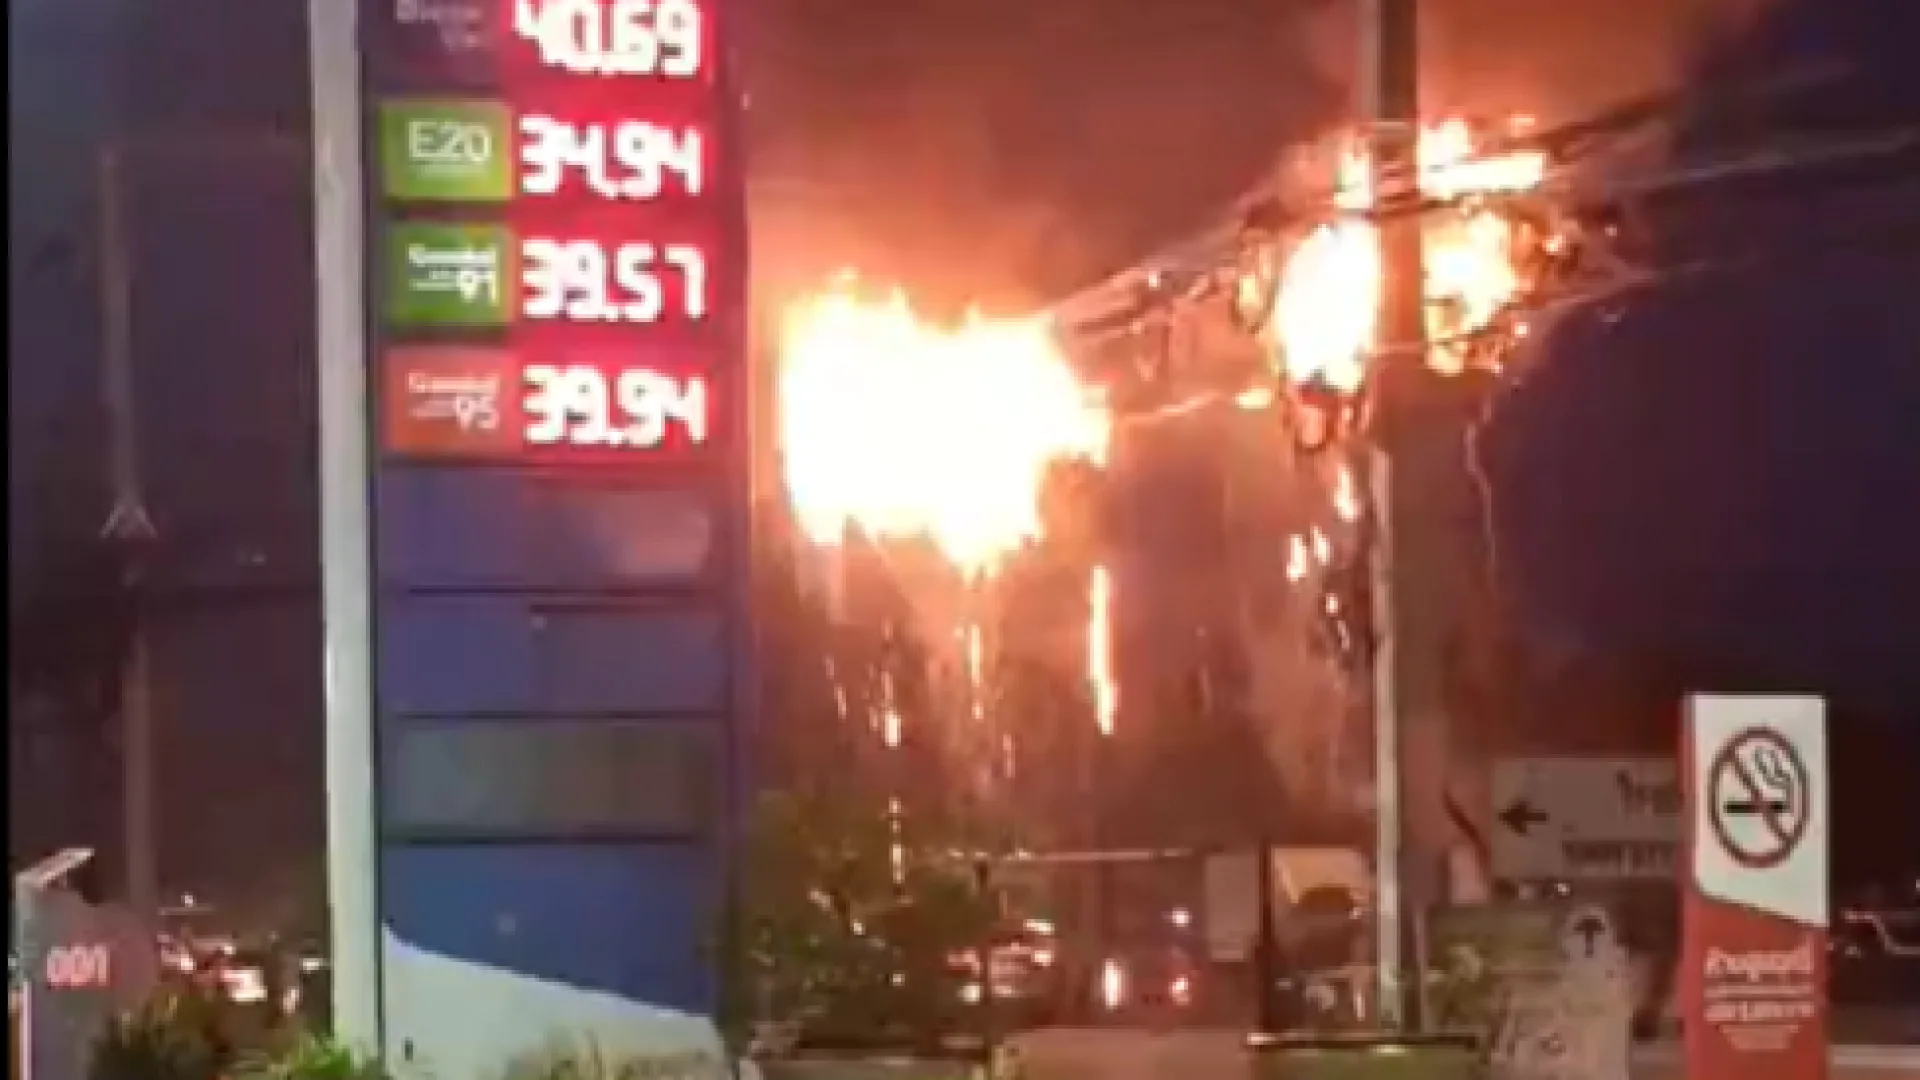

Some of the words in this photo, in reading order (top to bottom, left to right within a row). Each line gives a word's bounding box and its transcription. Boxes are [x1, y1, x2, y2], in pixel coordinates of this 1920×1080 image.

[513, 0, 702, 77] 40.69
[408, 121, 492, 162] E20
[519, 114, 702, 199] 34.94
[458, 268, 498, 305] 91
[521, 238, 707, 321] 39.57
[456, 395, 499, 433] 95
[521, 363, 707, 447] 39.94
